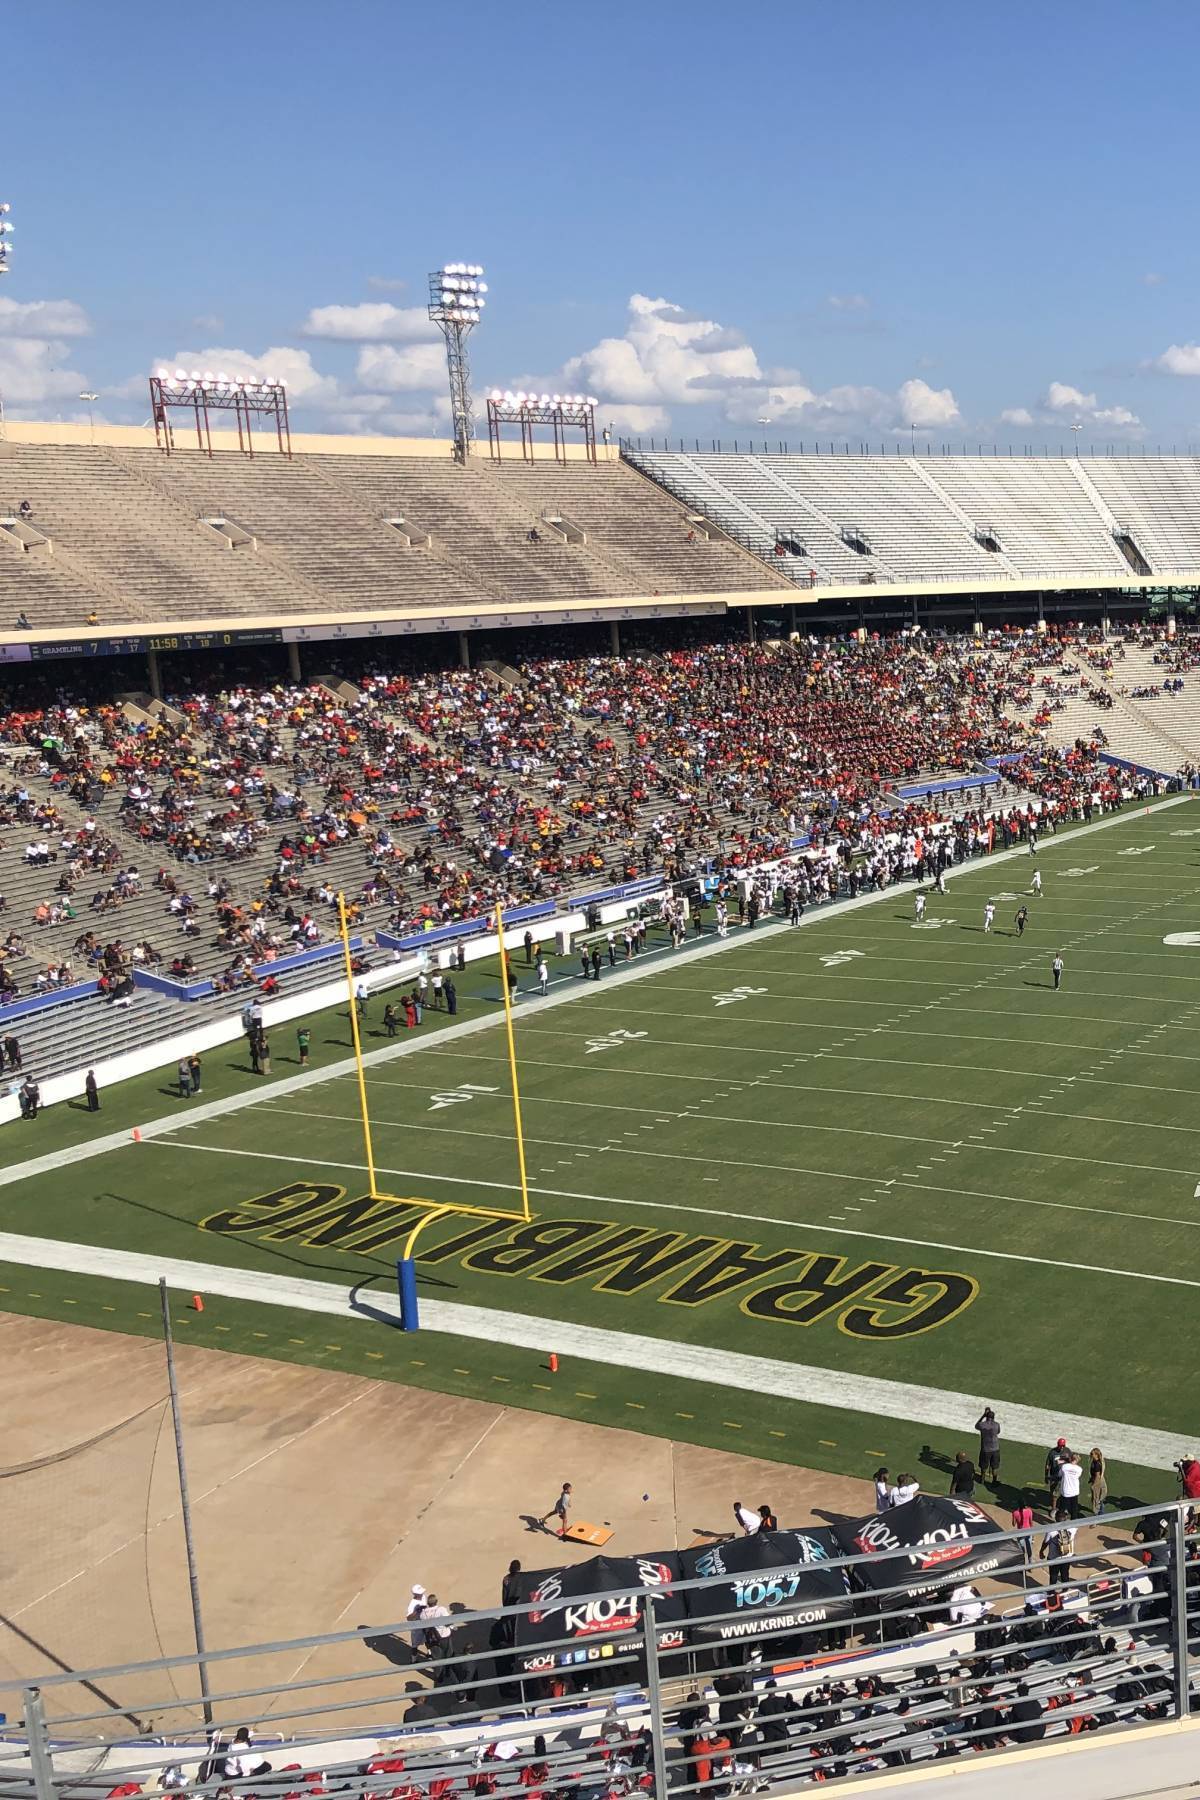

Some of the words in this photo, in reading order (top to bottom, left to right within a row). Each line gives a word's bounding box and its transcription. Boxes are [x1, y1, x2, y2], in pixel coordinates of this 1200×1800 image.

[90, 643, 98, 654] 7
[150, 638, 178, 650] 11:58
[224, 634, 231, 645] 0
[42, 645, 82, 655] GRAMBLING
[585, 1029, 648, 1047] 20
[430, 1083, 500, 1103] 10
[199, 1180, 981, 1342] GRAMBLING
[734, 1576, 800, 1608] 105.7
[565, 1595, 639, 1632] K104
[720, 1609, 827, 1639] WWW.KRNB.COM
[523, 1654, 556, 1671] K104
